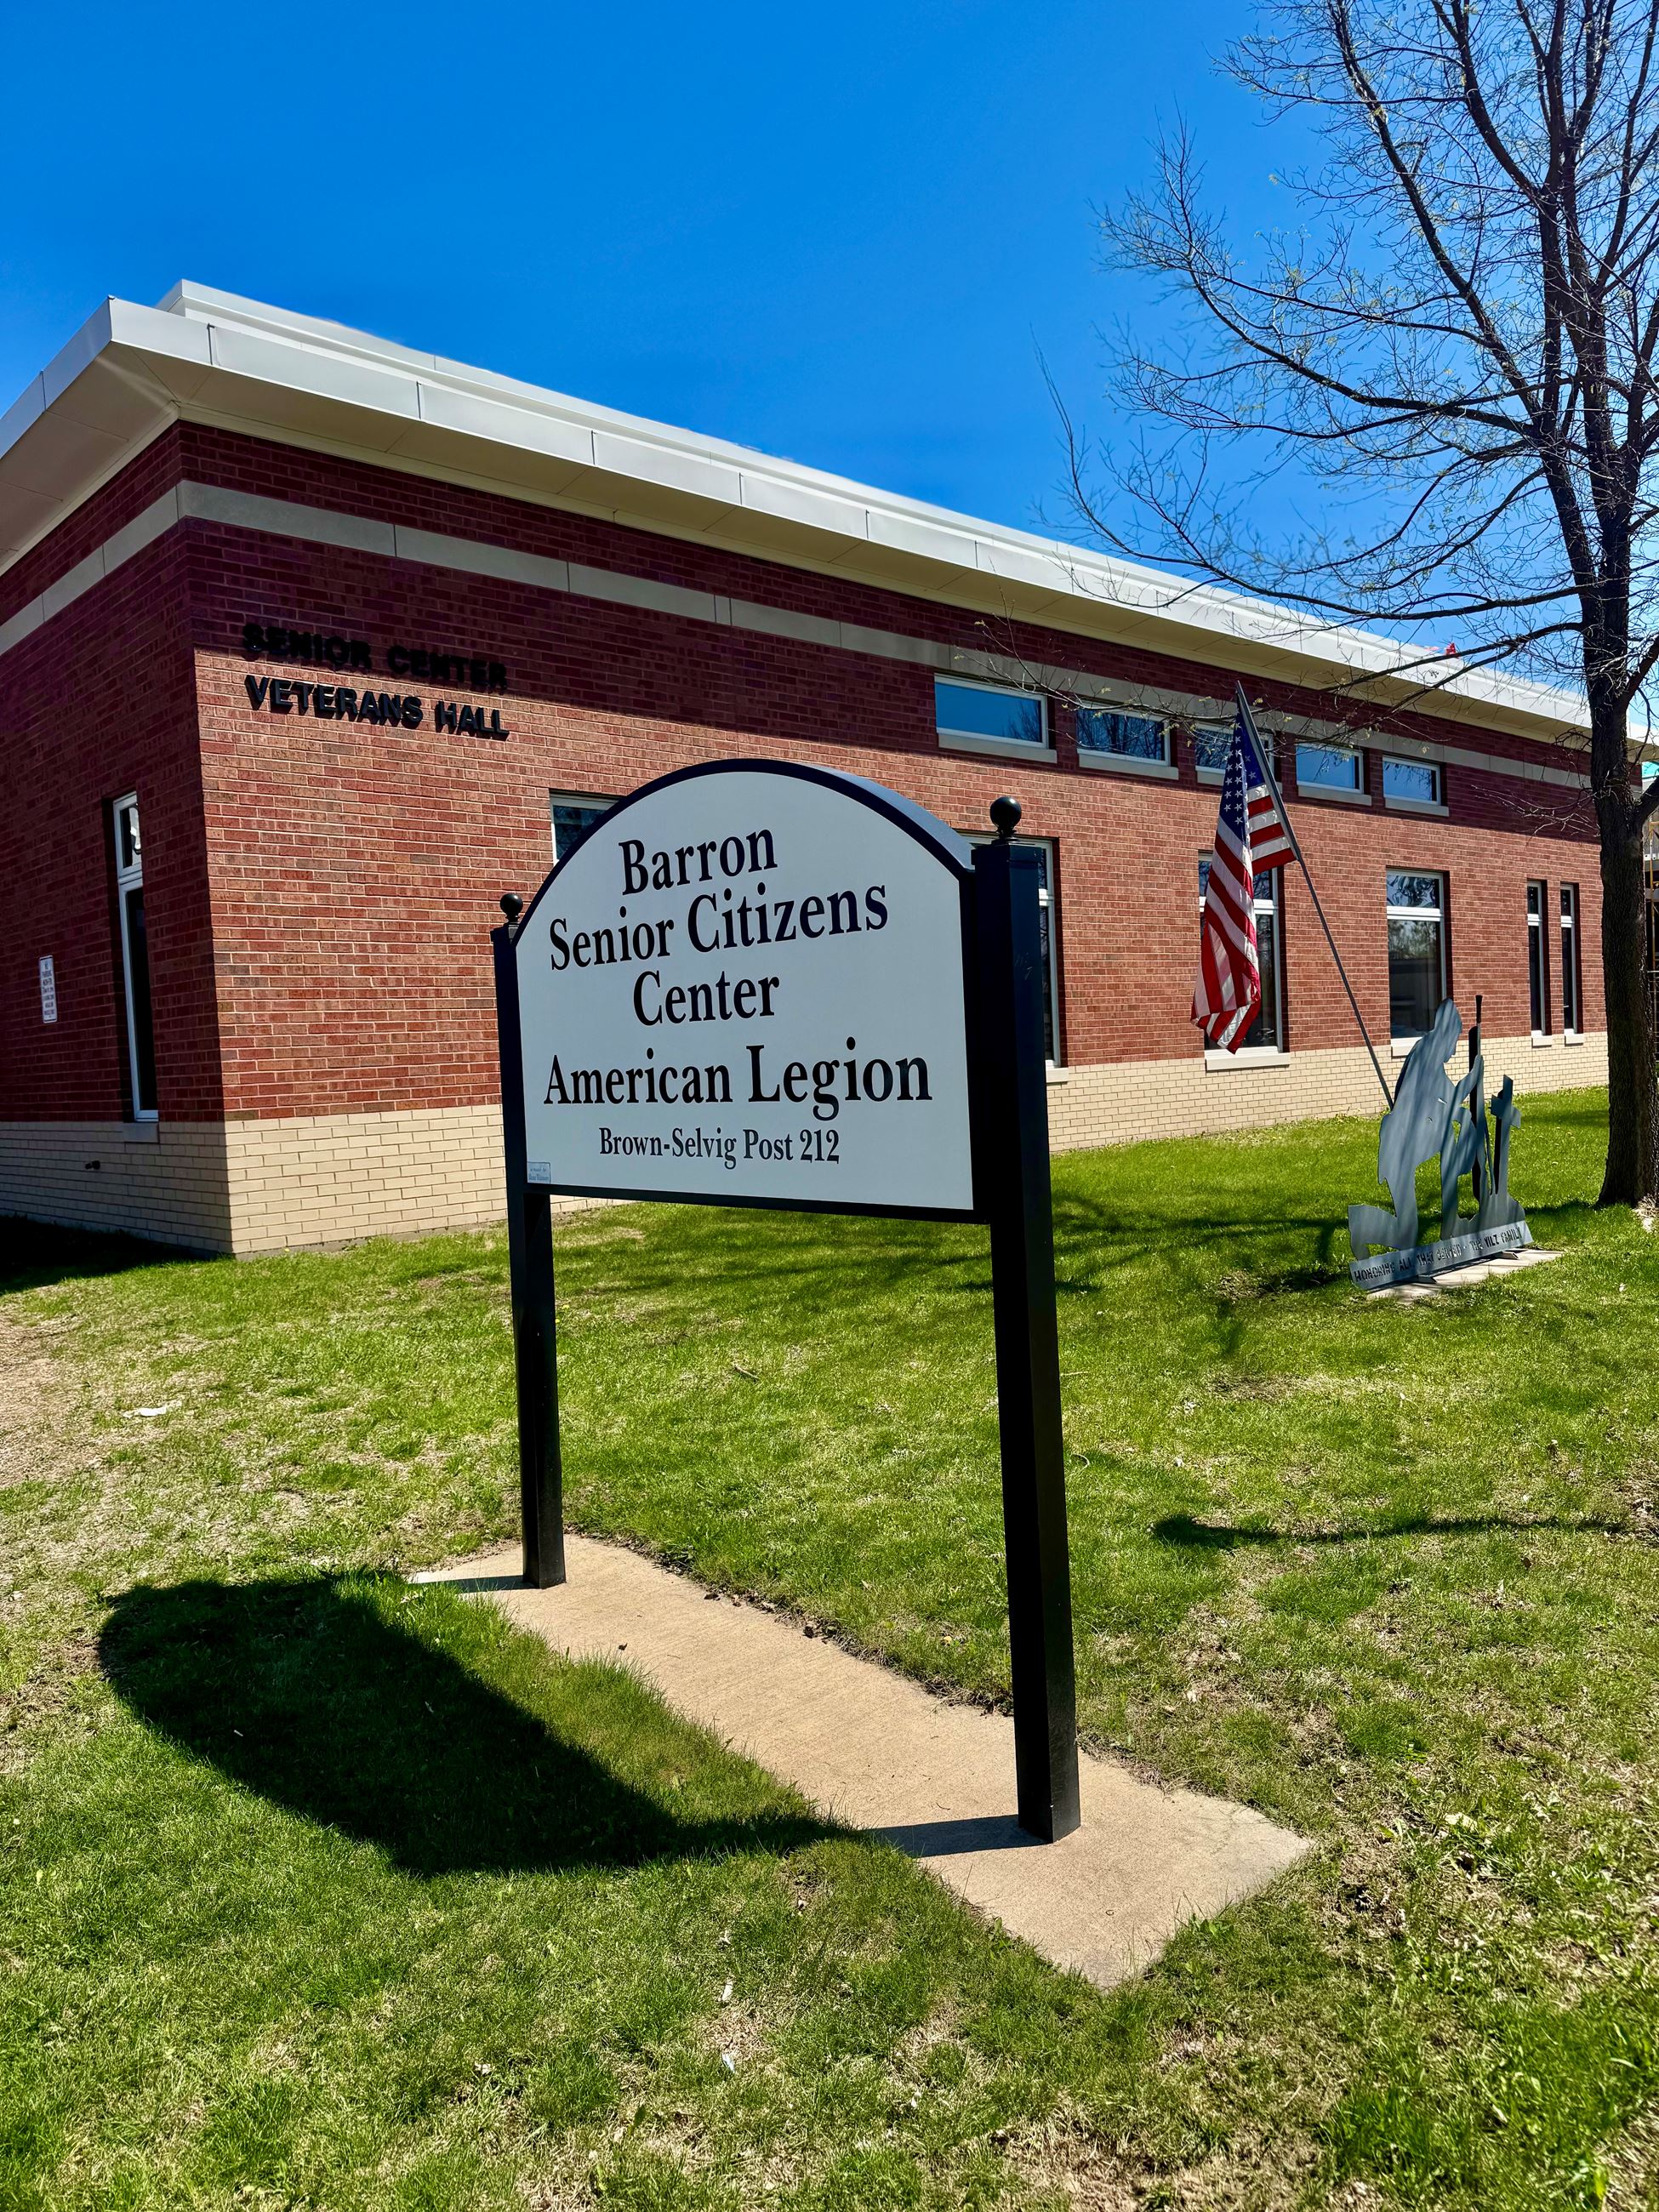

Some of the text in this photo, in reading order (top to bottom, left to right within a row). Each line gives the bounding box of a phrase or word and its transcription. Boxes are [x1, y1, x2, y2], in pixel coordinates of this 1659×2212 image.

[242, 624, 508, 691] SENIOR CENTER
[244, 675, 510, 741] VETERANS HALL
[619, 830, 778, 896] Barron
[550, 882, 888, 971] Senior Citizens
[633, 971, 780, 1027] Center
[543, 1037, 933, 1121] American Legion
[599, 1127, 840, 1171] Brown-Selvig Post 212
[1354, 1262, 1395, 1282] HONORING
[1417, 1251, 1434, 1266] THAT
[1500, 1226, 1523, 1244] FAMILY
